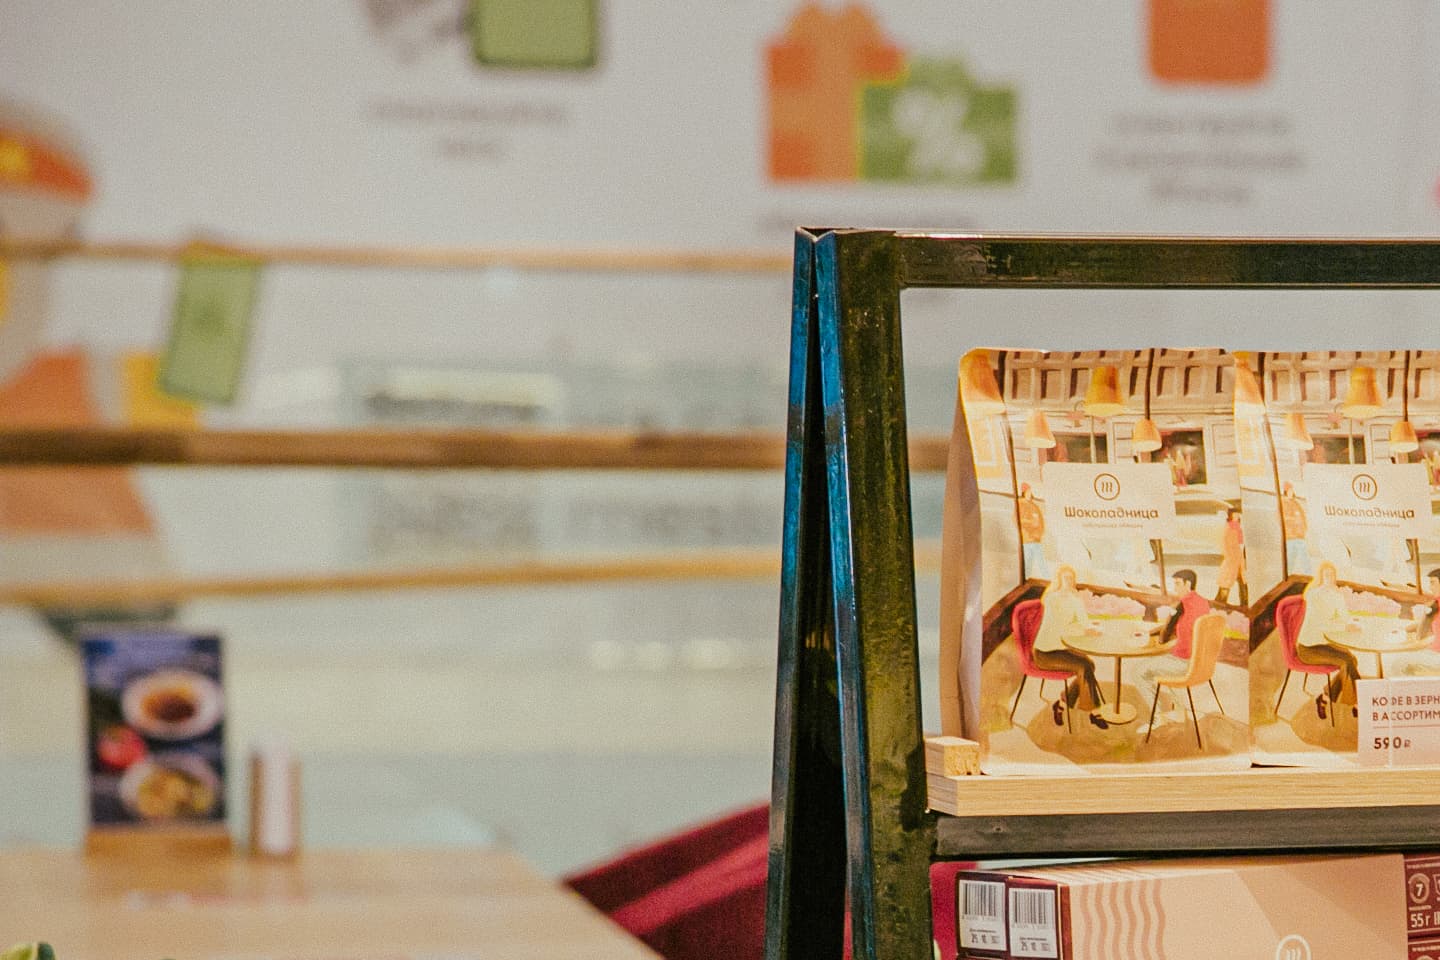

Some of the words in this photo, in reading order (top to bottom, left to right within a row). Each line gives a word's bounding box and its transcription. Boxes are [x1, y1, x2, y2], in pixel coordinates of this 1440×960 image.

[1064, 506, 1159, 519] Шоколадница
[1325, 505, 1415, 519] Шоколадница
[1406, 696, 1412, 705] В
[1373, 712, 1379, 721] В
